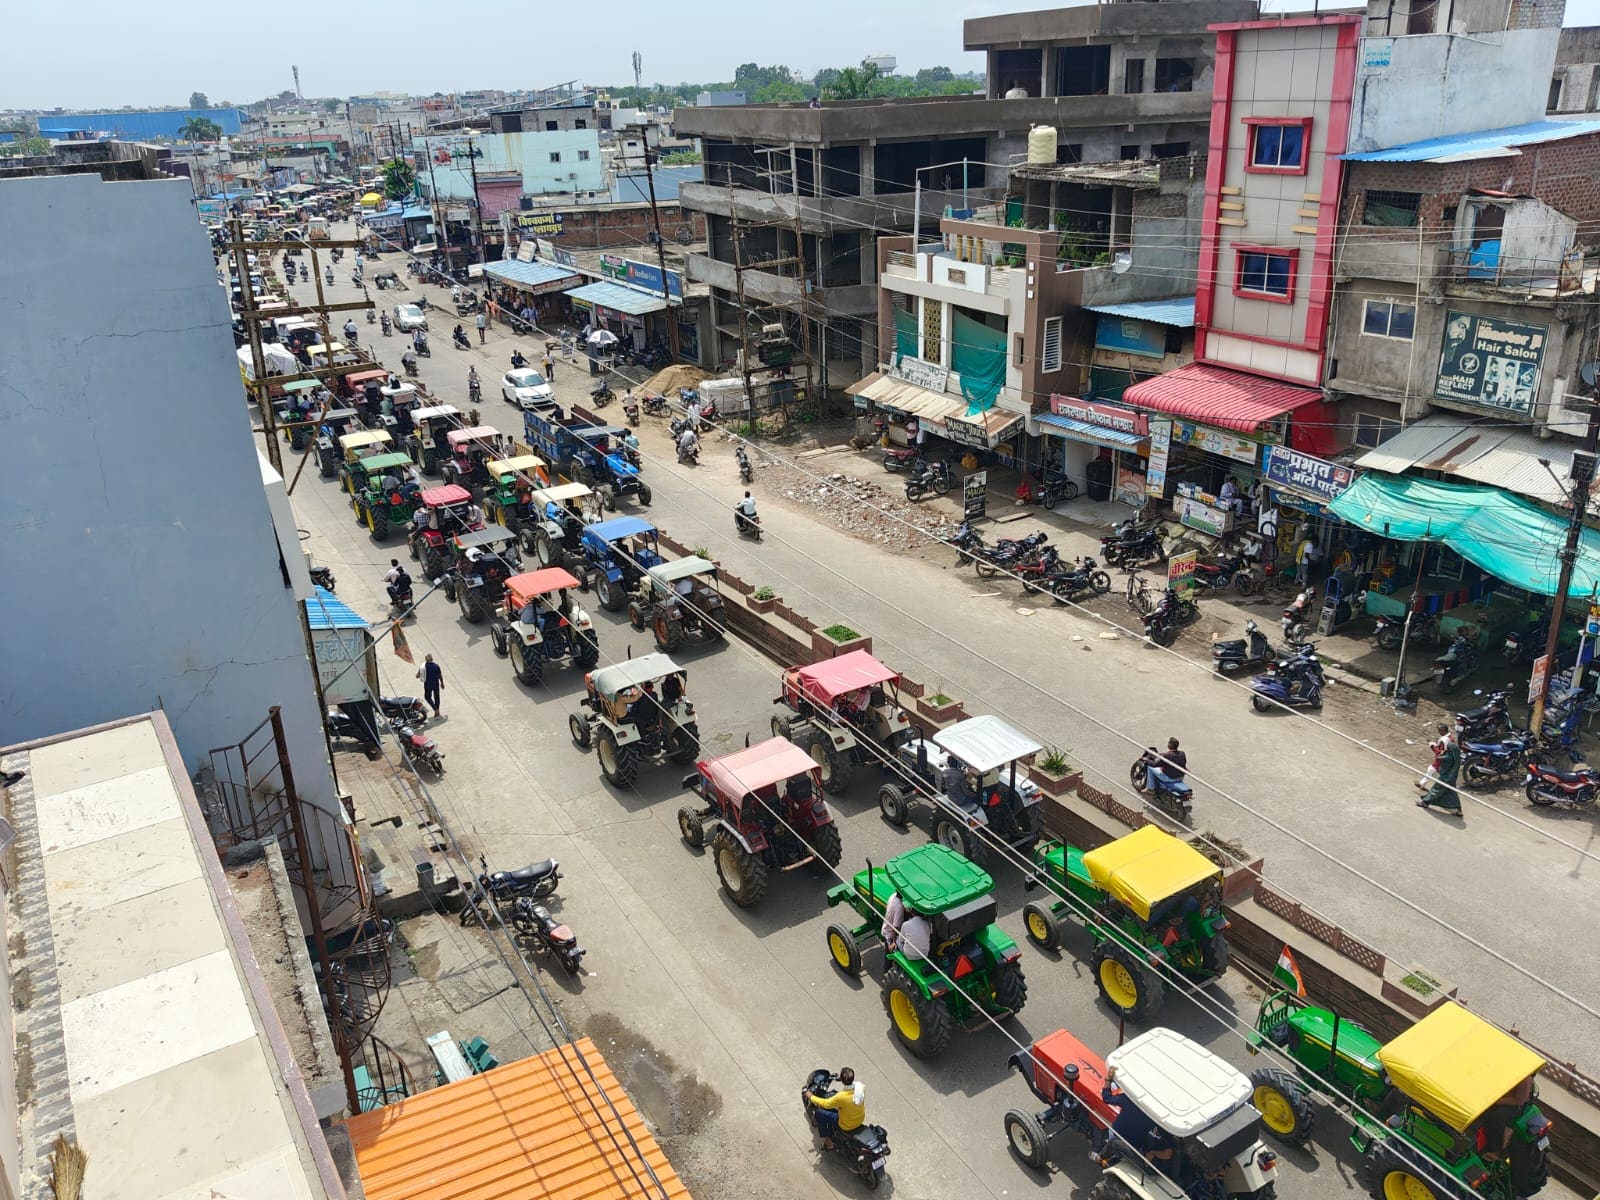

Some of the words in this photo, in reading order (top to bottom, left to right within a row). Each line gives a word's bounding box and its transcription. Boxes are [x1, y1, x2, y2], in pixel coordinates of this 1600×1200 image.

[1477, 340, 1502, 354] Hair
[1503, 345, 1538, 360] Salon
[1439, 378, 1473, 391] REFLECT
[1452, 375, 1475, 386] HAIR
[1289, 453, 1332, 479] प्रभात
[1291, 471, 1316, 488] ऑटो
